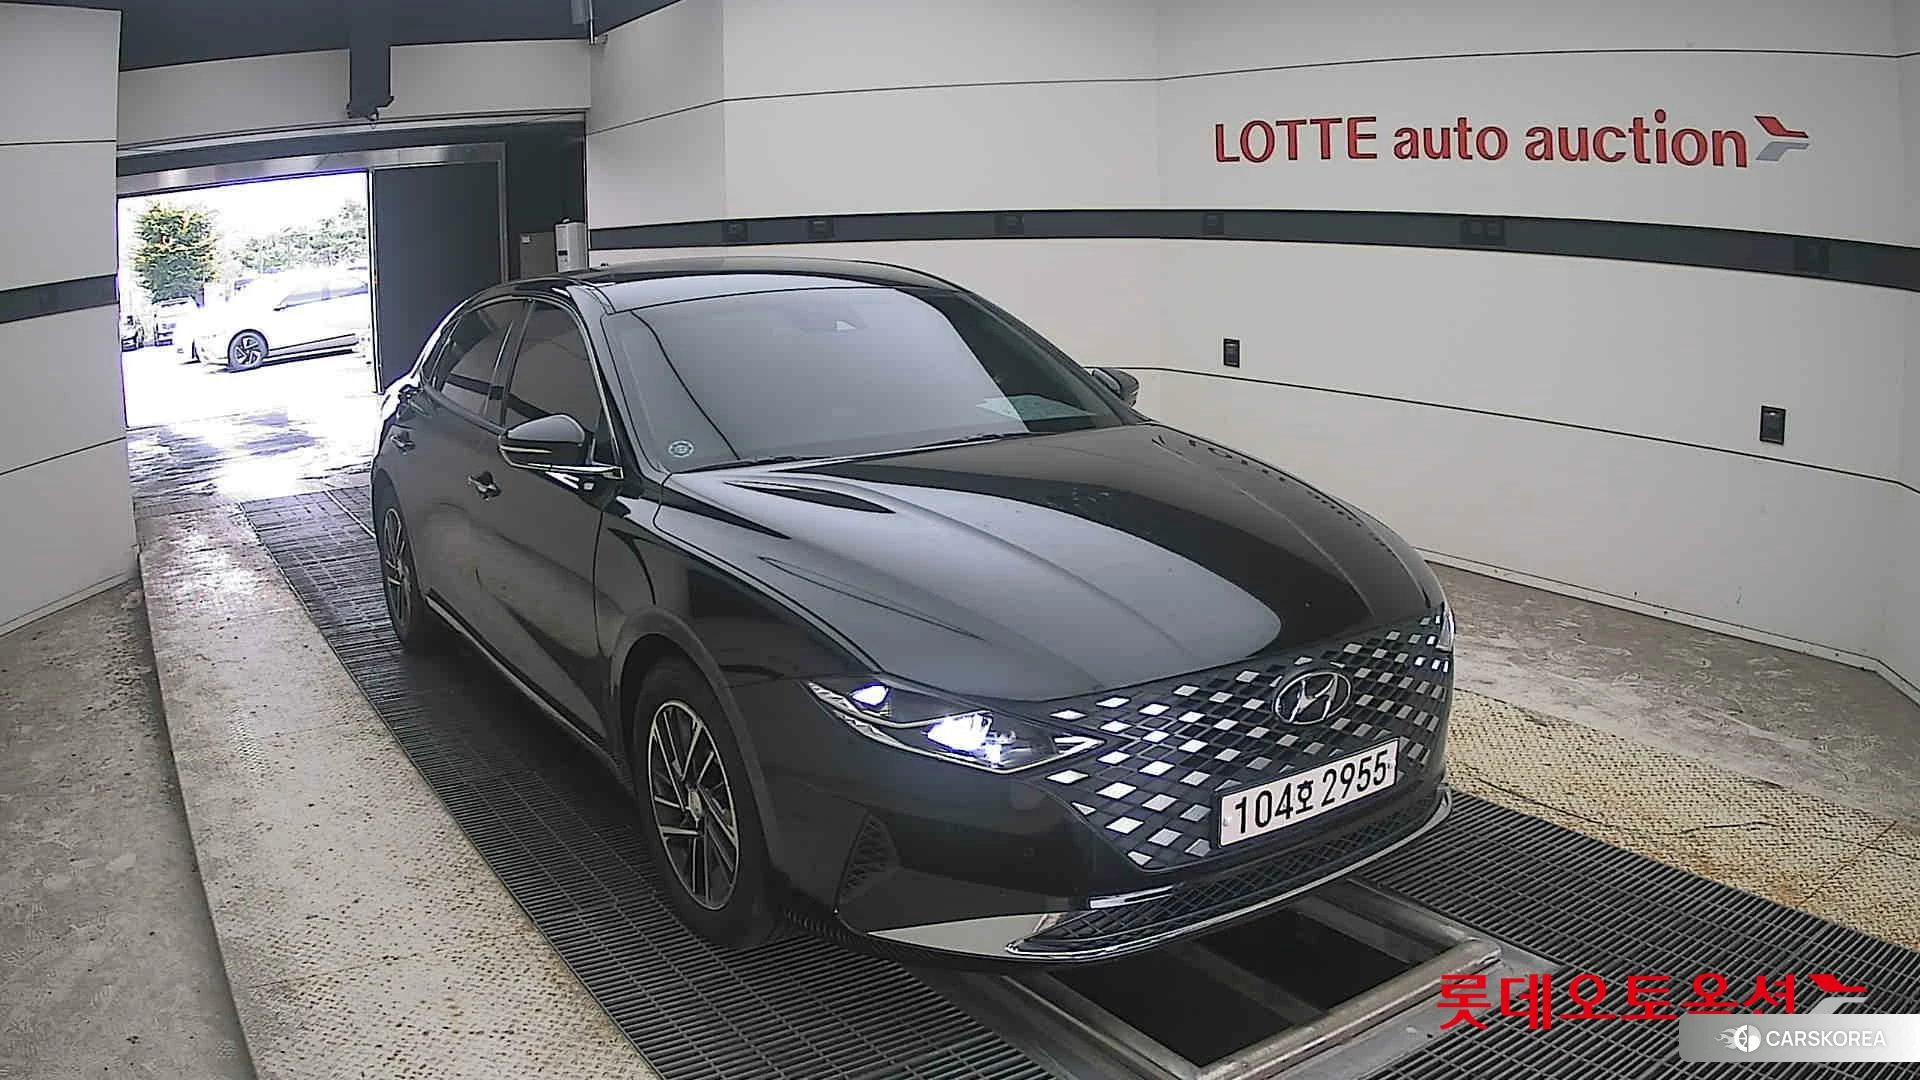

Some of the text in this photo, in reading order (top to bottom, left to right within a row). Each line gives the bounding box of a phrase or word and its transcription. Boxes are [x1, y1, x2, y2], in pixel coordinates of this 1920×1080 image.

[1214, 109, 1748, 168] LOTTE auto auction
[1235, 749, 1388, 834] 104호 2955
